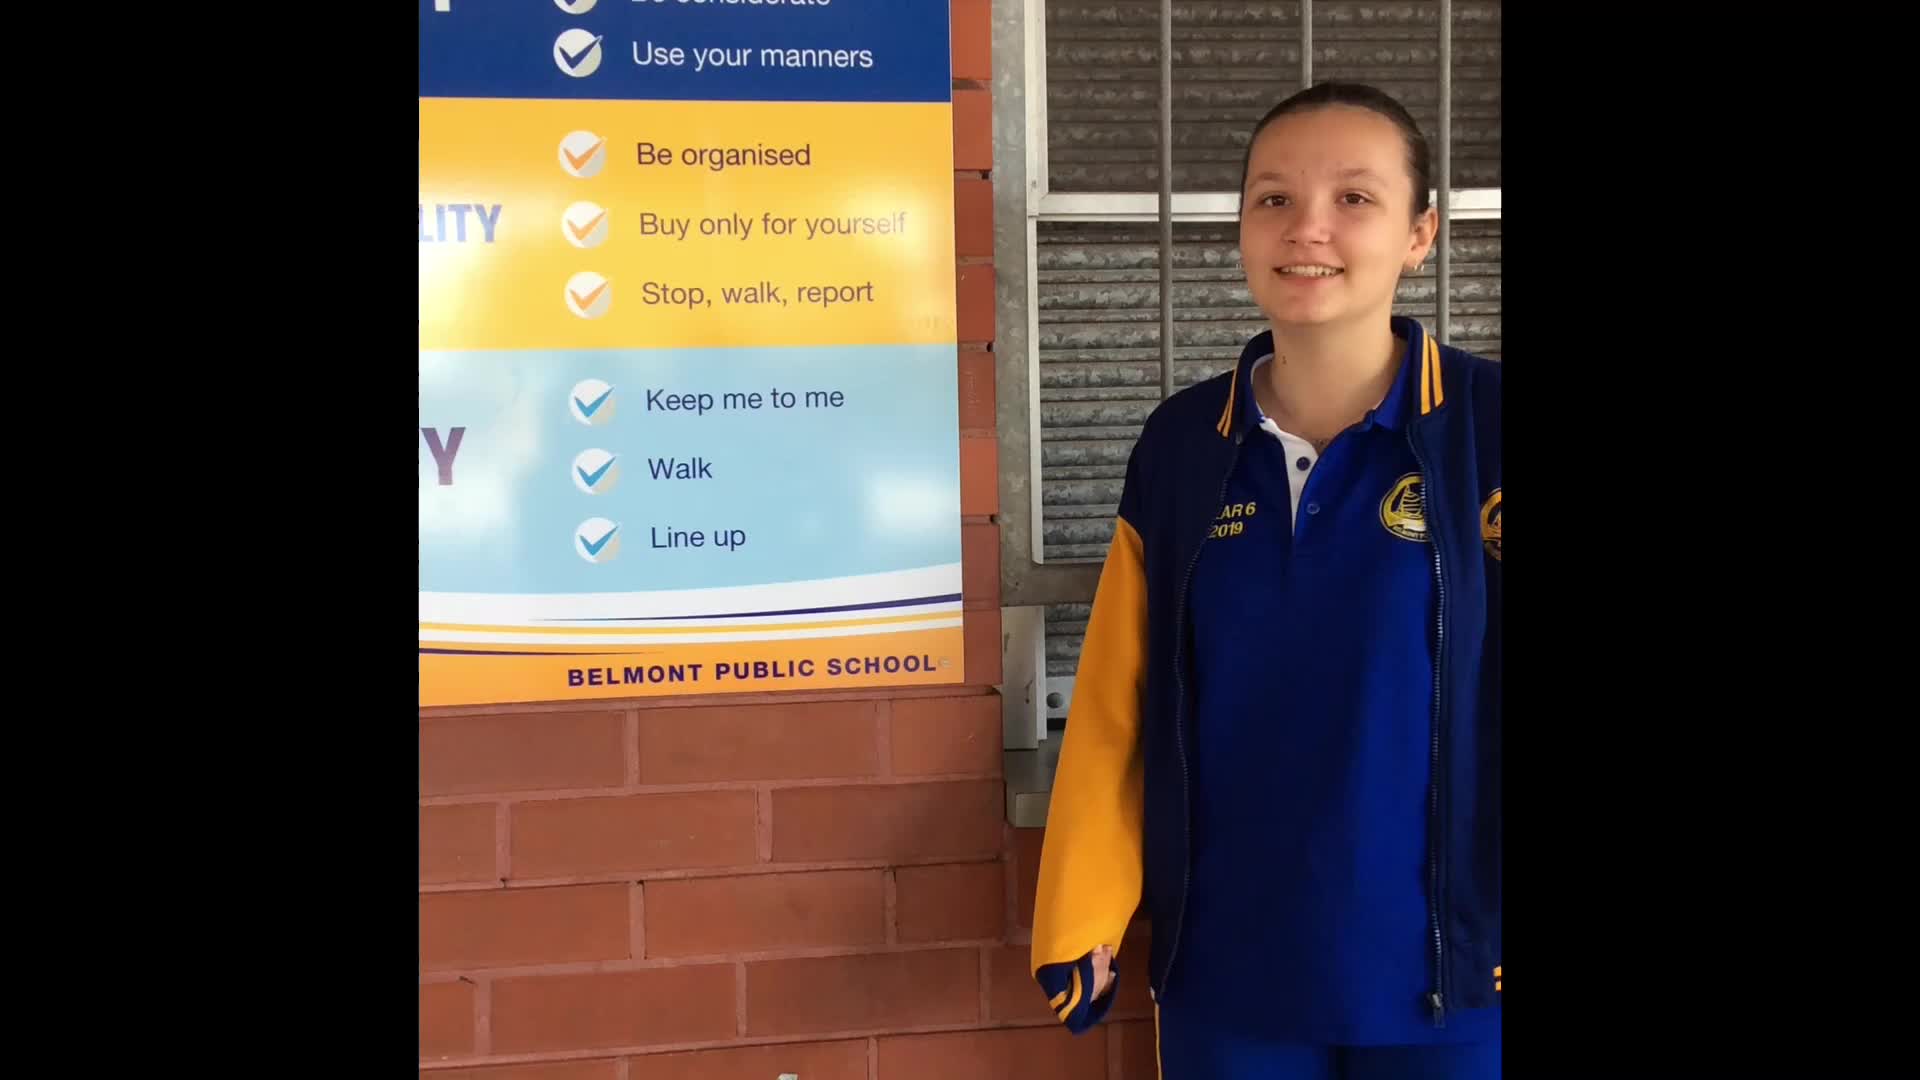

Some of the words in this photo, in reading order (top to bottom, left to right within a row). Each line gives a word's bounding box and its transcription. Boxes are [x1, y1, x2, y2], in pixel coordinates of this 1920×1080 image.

[632, 41, 685, 66] Use
[693, 48, 752, 72] your
[760, 49, 874, 68] manners
[637, 142, 673, 166] Be
[681, 144, 811, 172] organised
[639, 213, 690, 241] Buy
[699, 213, 754, 241] only
[761, 212, 798, 236] for
[804, 211, 908, 241] yourself
[642, 281, 713, 310] Stop,
[720, 281, 788, 307] walk,
[797, 282, 875, 309] report
[646, 388, 714, 417] Keep
[723, 392, 763, 410] me
[770, 388, 796, 409] to
[805, 391, 845, 408] me
[420, 427, 466, 486] Y
[647, 457, 713, 480] Walk
[1245, 501, 1257, 516] 6
[651, 526, 705, 549] Line
[714, 530, 746, 552] up
[1207, 521, 1244, 539] 2019
[566, 664, 702, 687] BELMONT
[715, 659, 815, 682] PUBLIC
[827, 655, 937, 677] SCHOOL
